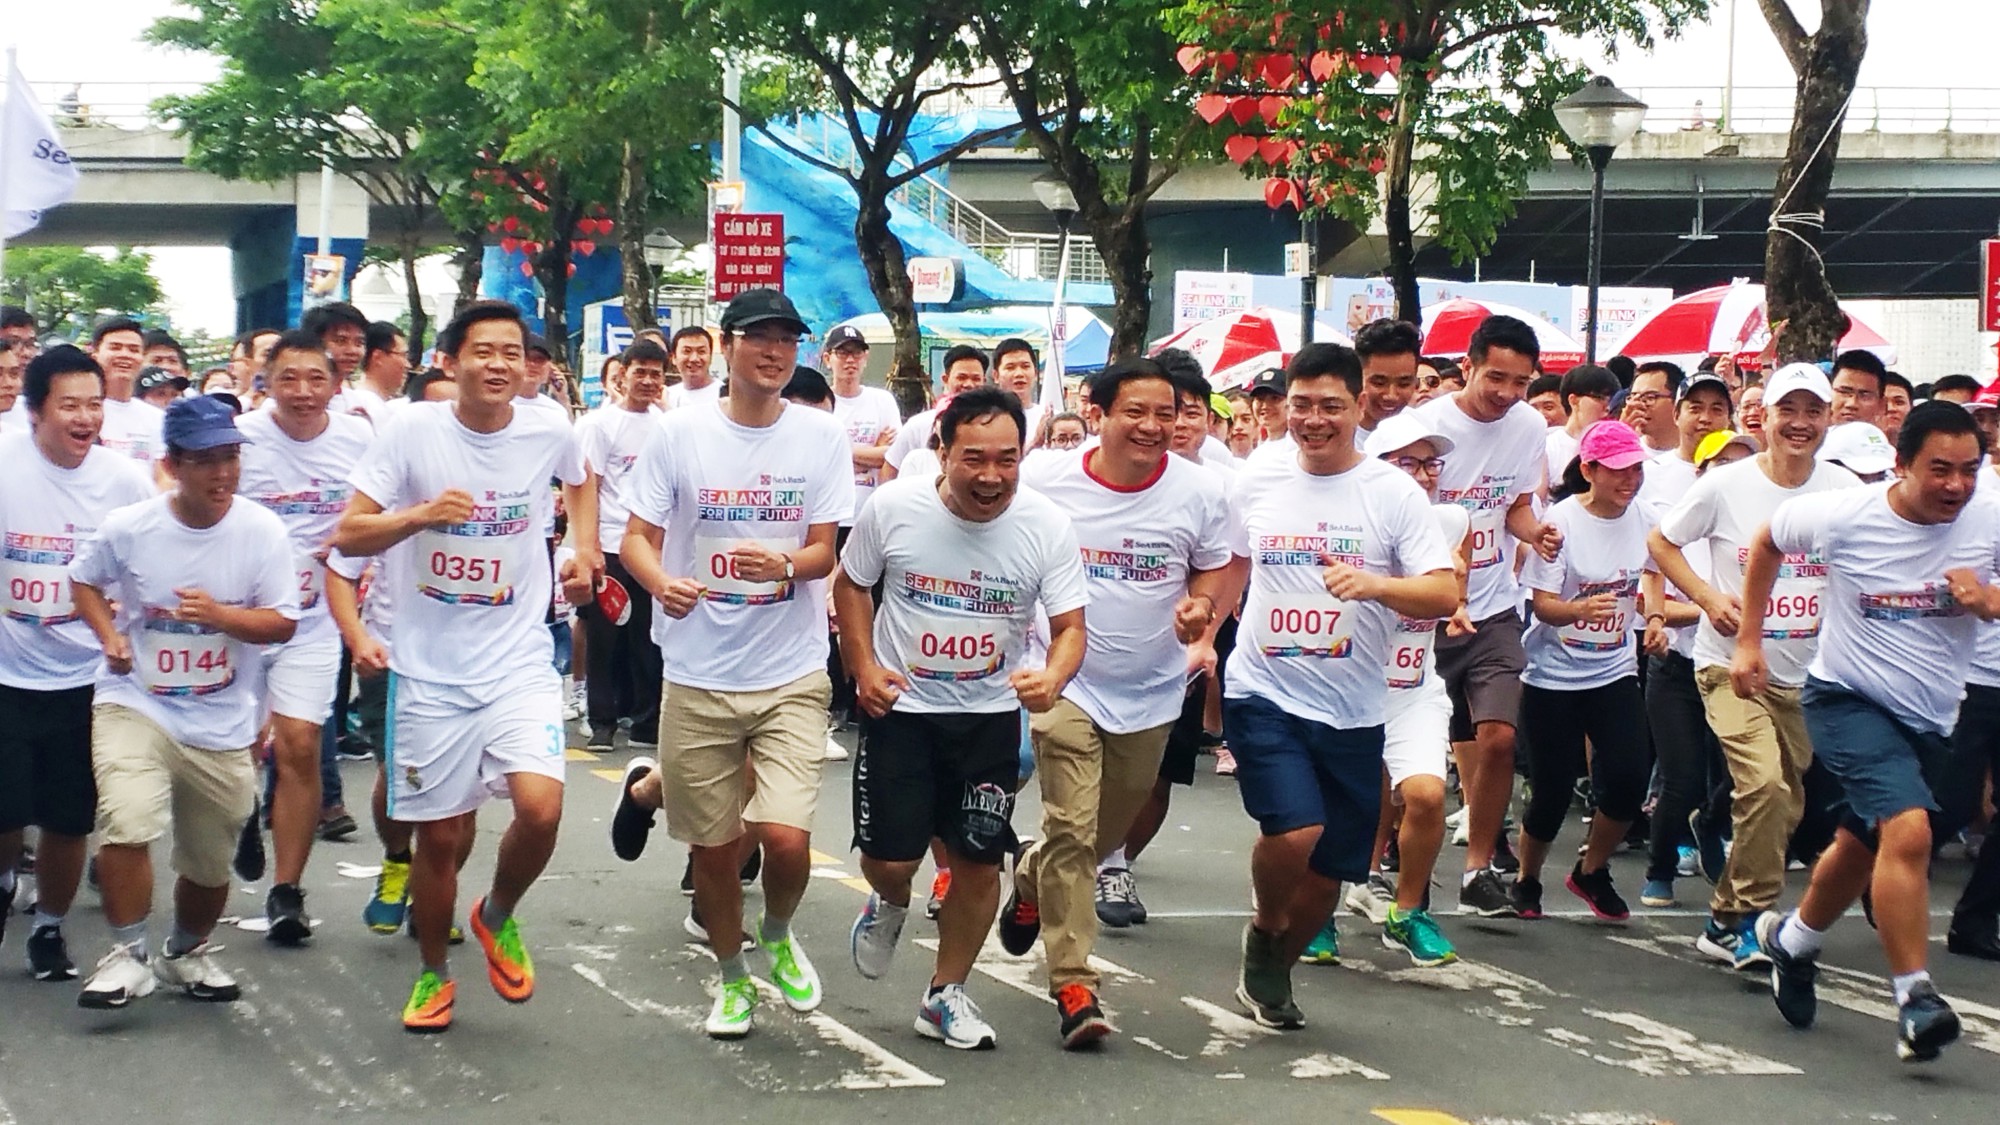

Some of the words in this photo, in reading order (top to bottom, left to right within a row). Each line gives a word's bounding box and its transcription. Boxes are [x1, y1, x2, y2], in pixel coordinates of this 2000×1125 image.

[33, 138, 71, 165] Se
[761, 222, 772, 236] XE
[699, 488, 771, 506] SEABANK
[775, 490, 804, 506] RUN
[698, 506, 725, 520] FOR
[727, 507, 754, 521] THE
[1259, 535, 1328, 552] SEABANK
[1331, 537, 1365, 554] RUN
[1472, 528, 1495, 551] 01
[430, 551, 501, 584] 0351
[1136, 554, 1169, 569] RUN
[1260, 551, 1284, 565] FOR
[1285, 552, 1312, 565] THE
[1089, 565, 1116, 579] THE
[904, 571, 981, 600] SEABANK
[984, 587, 1017, 604] RUN
[1270, 608, 1342, 635] 0007
[920, 632, 996, 660] 0405
[157, 646, 228, 673] 0144
